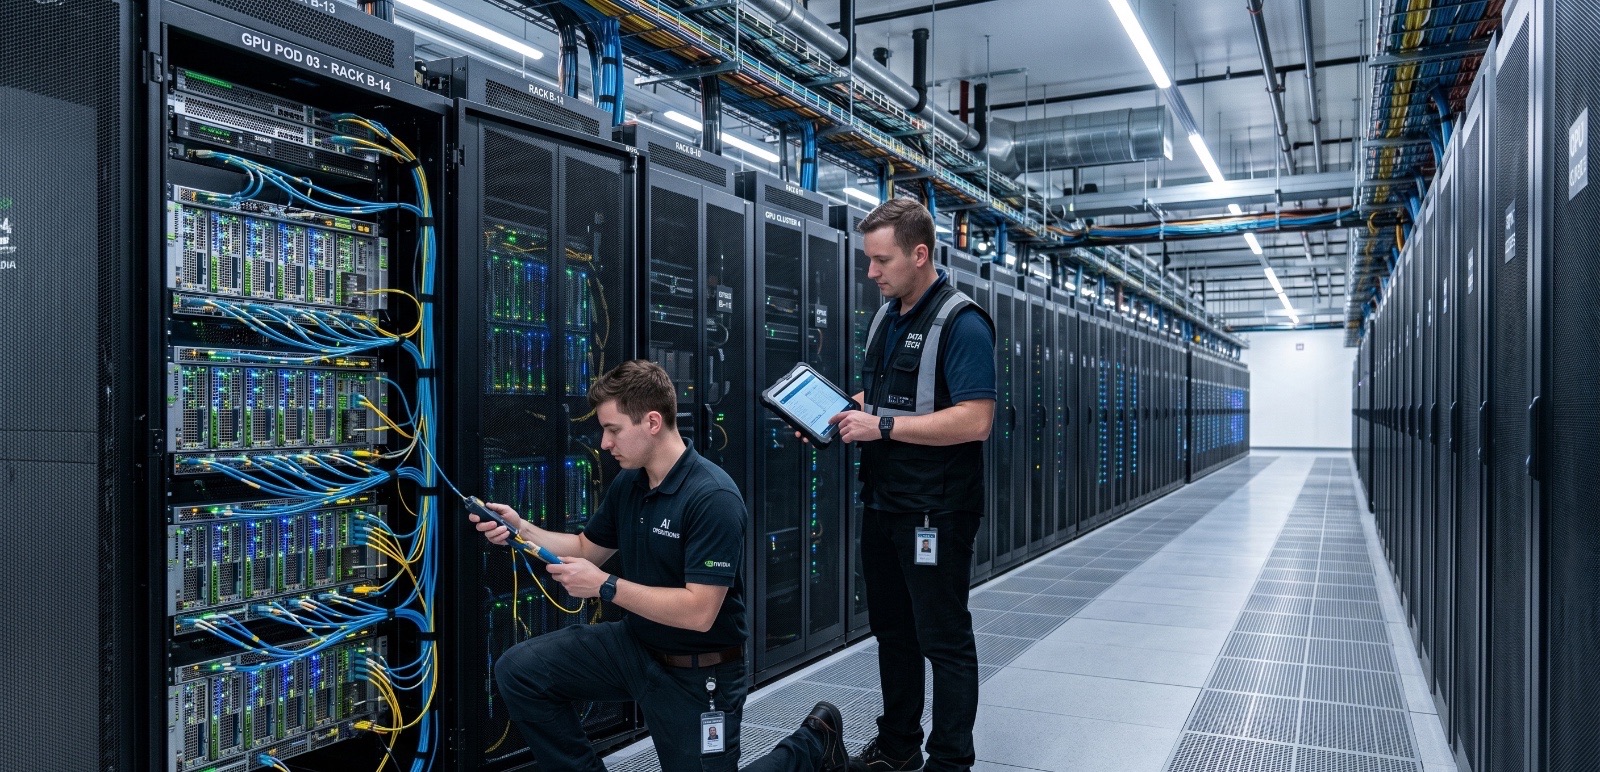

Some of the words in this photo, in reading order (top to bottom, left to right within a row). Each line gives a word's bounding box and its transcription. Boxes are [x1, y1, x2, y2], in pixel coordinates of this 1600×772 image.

[241, 33, 271, 52] GPU
[275, 43, 303, 63] POD
[306, 54, 320, 69] 03
[331, 63, 365, 84] RACK
[367, 75, 391, 93] B-14
[528, 84, 549, 101] RACK
[765, 211, 776, 221] GPU
[776, 214, 798, 226] CLUSTER
[907, 332, 923, 341] DATA
[904, 341, 921, 349] TECH
[660, 518, 671, 530] AI
